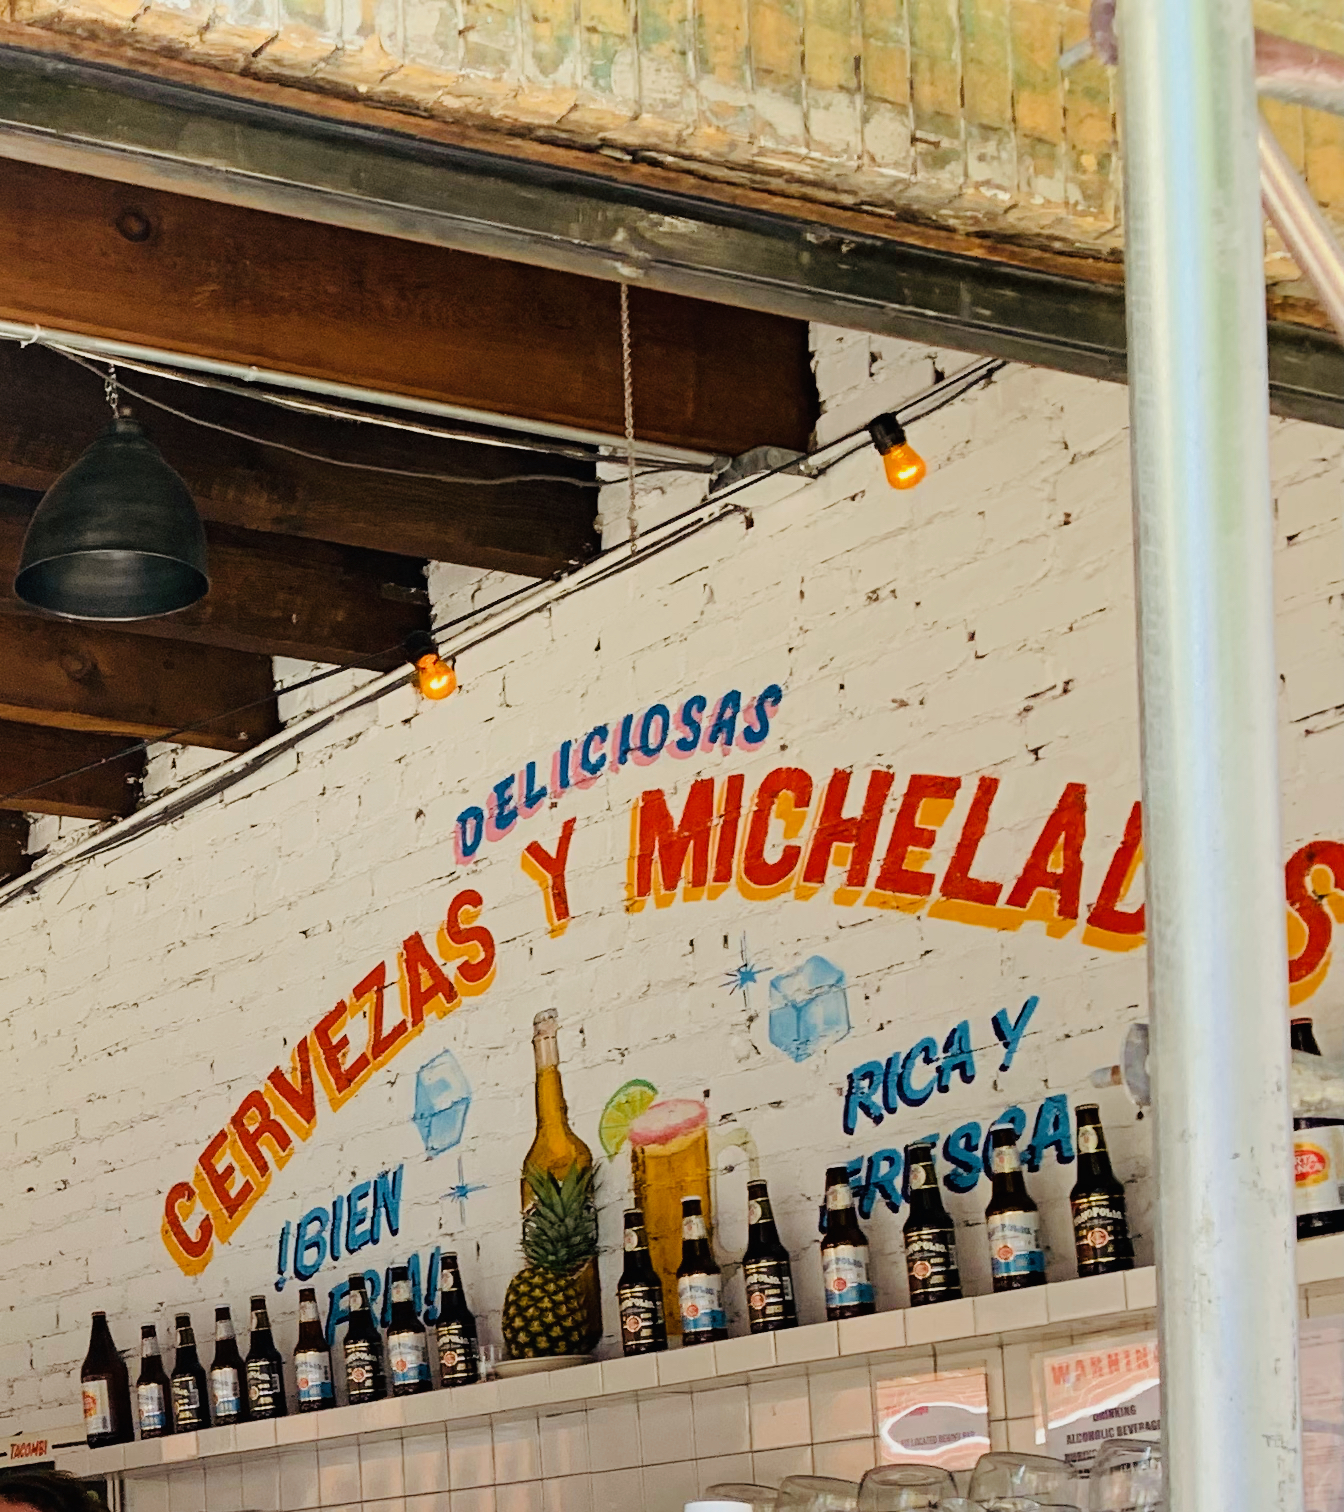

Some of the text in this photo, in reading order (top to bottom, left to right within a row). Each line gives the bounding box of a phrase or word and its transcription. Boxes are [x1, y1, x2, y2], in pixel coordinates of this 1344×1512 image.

[454, 684, 783, 866] DELICIOSAS
[161, 767, 1344, 1277] CERVEZAS Y MICHELADS
[843, 995, 1041, 1136] RICA Y
[1051, 1345, 1159, 1386] WARNIN
[10, 1440, 48, 1460] TACOMBI
